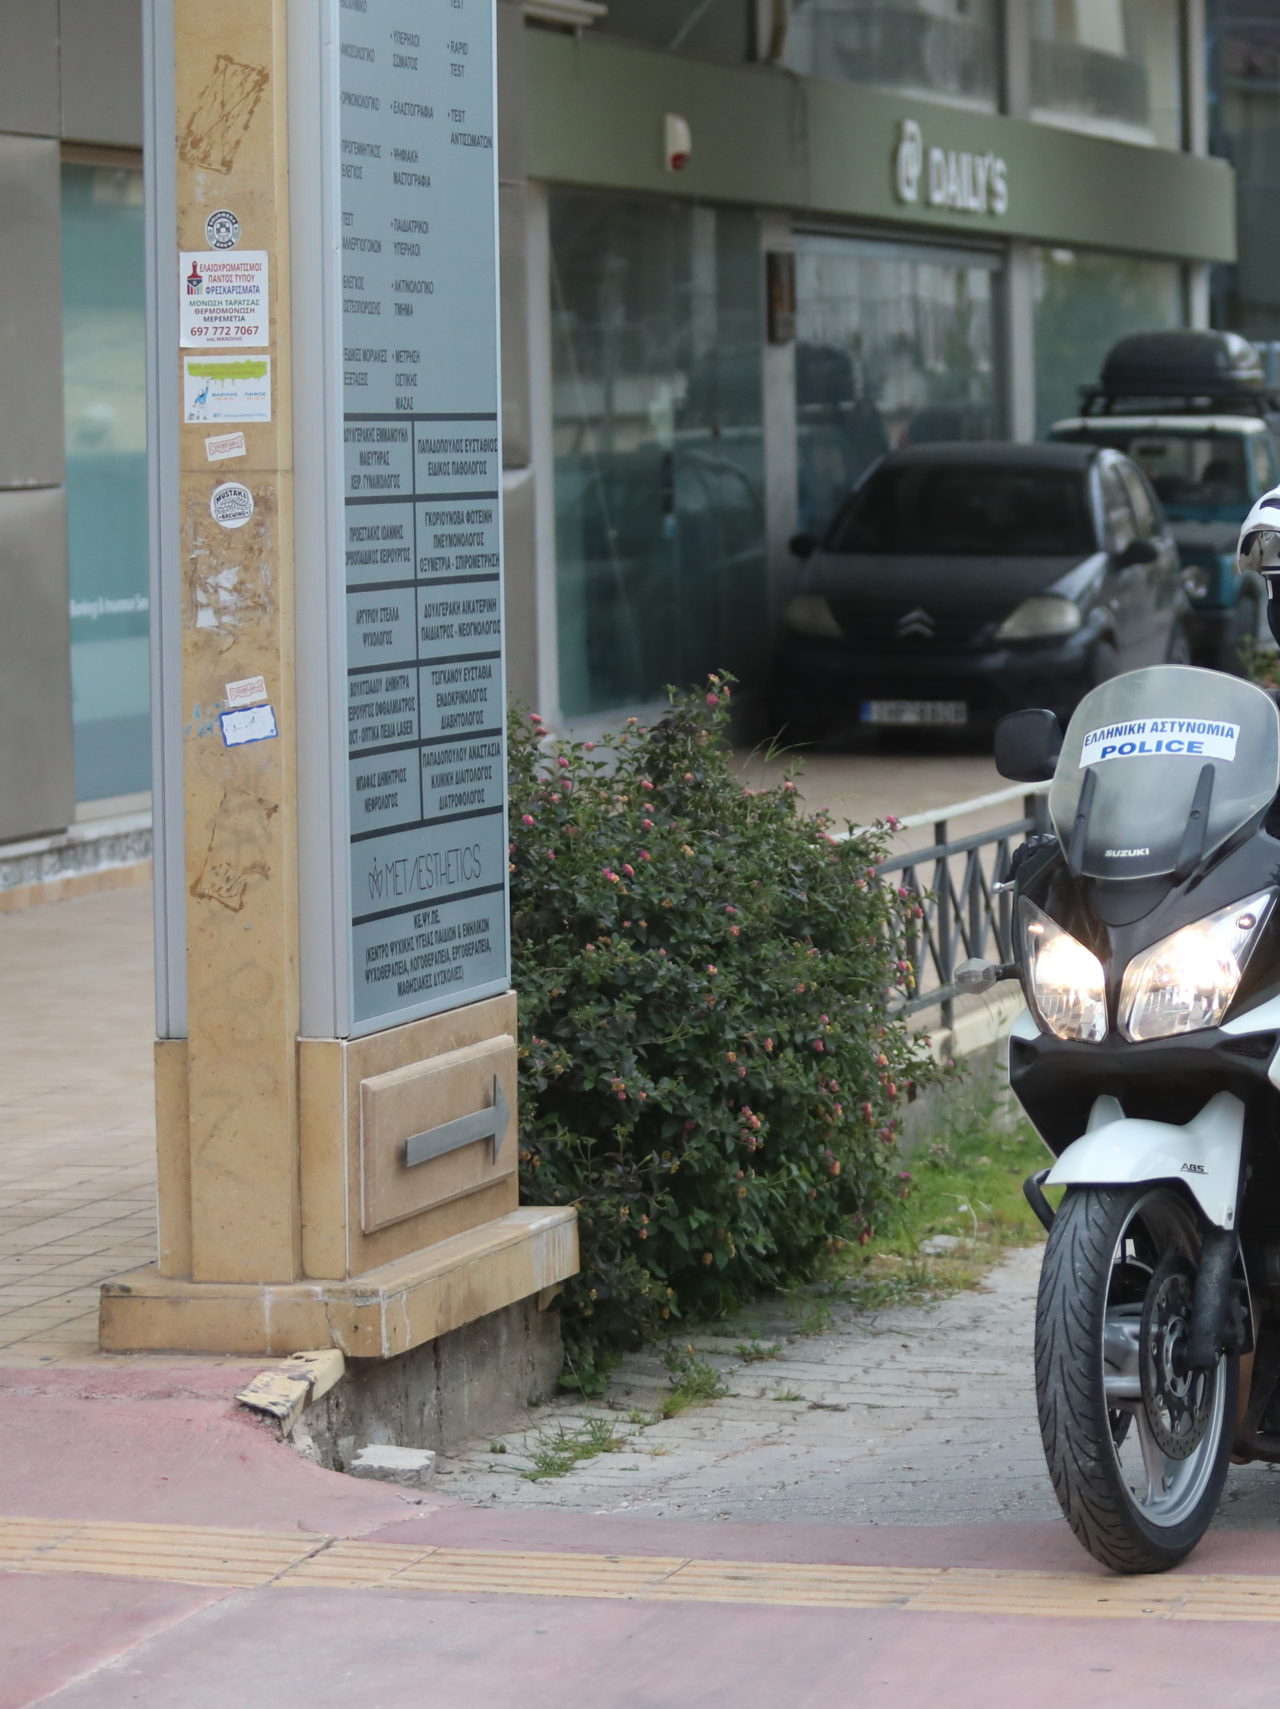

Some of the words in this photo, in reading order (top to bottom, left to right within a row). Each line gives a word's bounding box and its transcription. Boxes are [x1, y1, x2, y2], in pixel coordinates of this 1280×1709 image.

[450, 41, 468, 55] RAPID
[393, 54, 418, 71] ΣΩΜΑΤΟΣ
[450, 64, 465, 77] TEST
[394, 101, 433, 119] ΕΛΑΣΤΟΓΡΑΦΙΑ
[451, 110, 465, 123] TEST
[451, 132, 493, 149] ΑΝΤΙΣΩΜΑΤΩΝ
[393, 171, 431, 188] ΜΑΣΤΟΓΡΑΦΙΑ
[929, 147, 1008, 214] DAILY'S
[200, 263, 262, 272] ΕΛΑΙΟΧΡΩΜΑΤΙΣΜΟΙ
[208, 274, 233, 283] ΠΑΝΤΟΣ
[235, 274, 255, 283] ΤΥΠΟΥ
[394, 279, 434, 294] ΑΚΤΙΝΟΛΟΓΙΚΟ
[206, 285, 260, 295] ΦΡΕΣΚΑΡΙΣΜΑΤΑ
[394, 303, 414, 316] ΤΜΗΜΑ
[190, 327, 209, 336] 697
[213, 327, 231, 335] 772
[234, 326, 259, 335] 7067
[395, 350, 420, 363] ΜΕΤΡΗΣΗ
[395, 373, 418, 387] ΟΣΤΙΚΗΣ
[396, 397, 414, 410] ΜΑΖΑΣ
[376, 427, 408, 442] ΕΜΜΑΝΟΥΗΛ
[418, 439, 463, 454] ΠΑΠΑΔΟΠΟΥΛΟΣ
[465, 438, 497, 453] ΕΥΣΤΑΘΙΟΣ
[360, 451, 389, 466] ΜΑΙΕΥΤΗΡΑΣ
[428, 462, 450, 476] ΕΙΔΙΚΟΣ
[452, 461, 487, 475] ΠΑΘΟΛΟΓΟΣ
[216, 489, 246, 504] MUSTAKI
[221, 511, 246, 519] BREWING
[466, 510, 492, 524] ΦΩΤΕΙΝΗ
[381, 525, 403, 540] ΙΩΑΝΝΗΣ
[434, 532, 484, 548] ΠΝΕΥΜΟΝΟΛΟΓΟΣ
[380, 547, 410, 563] ΧΕΙΡΟΥΡΓΟΣ
[420, 556, 450, 572] ΟΞΥΜΕΤΡΙΑ
[455, 553, 499, 570] ΣΠΙΡΟΜΕΤΡΗΣΗ
[380, 607, 399, 623] ΣΤΕΛΛΑ
[424, 601, 460, 618] ΔΟΥΛΓΕΡΑΚΗ
[462, 598, 496, 615] ΑΙΚΑΤΕΡΙΝΗ
[363, 630, 392, 647] ΨΥΧΟΛΟΓΟΣ
[421, 624, 454, 641] ΠΑΙΔΙΑΤΡΟΣ
[458, 620, 500, 637] ΝΕΟΓΝΟΛΟΓΟΣ
[431, 667, 463, 686] ΤΣΙΓΚΑΝΟΥ
[463, 664, 492, 682] ΕΥΣΤΑΘΙΑ
[385, 675, 409, 692] ΔΗΜΗΤΡΑ
[436, 688, 487, 707] ΕΝΔΟΚΡΙΝΟΛΟΓΟΣ
[348, 702, 374, 721] ΕΙΡΟΥΡΓΟΣ
[441, 710, 483, 730] ΔΙΑΒΗΤΟΛΟΓΟΣ
[380, 722, 395, 740] ΠΕΔΙΑ
[397, 720, 414, 737] LASER
[1085, 722, 1146, 747] ΕΛΛΗΝΙΚΗ
[1150, 720, 1235, 739] ΑΣΤΥΝΟΜΙΑ
[423, 746, 467, 767] ΠΑΠΑΔΟΠΟΥΛΟΥ
[468, 742, 500, 761] ΑΝΑΣΤΑΣΙΑ
[1100, 740, 1204, 759] POLICE
[377, 768, 407, 787] ΔΗΜΗΤΡΙΟΣ
[431, 770, 454, 789] ΚΛΙΝΙΚΗ
[455, 765, 492, 785] ΔΙΑΙΤΟΛΟΓΟΣ
[364, 793, 398, 813] ΝΕΦΡΟΛΟΓΟΣ
[439, 789, 485, 810] ΔΙΑΤΡΟΦΟΛΟΓΟΣ
[1105, 848, 1150, 858] SUZUKI
[389, 936, 414, 957] ΨΥΧΙΚΗΣ
[415, 931, 434, 950] ΥΓΕΙΑΣ
[434, 926, 456, 945] ΠΑΙΔΙΩΝ
[463, 918, 490, 937] ΕΝΗΛΙΚΩΝ
[398, 974, 433, 997] ΜΑΘΗΣΙΑΚΕΣ
[1180, 1162, 1205, 1173] ABS
